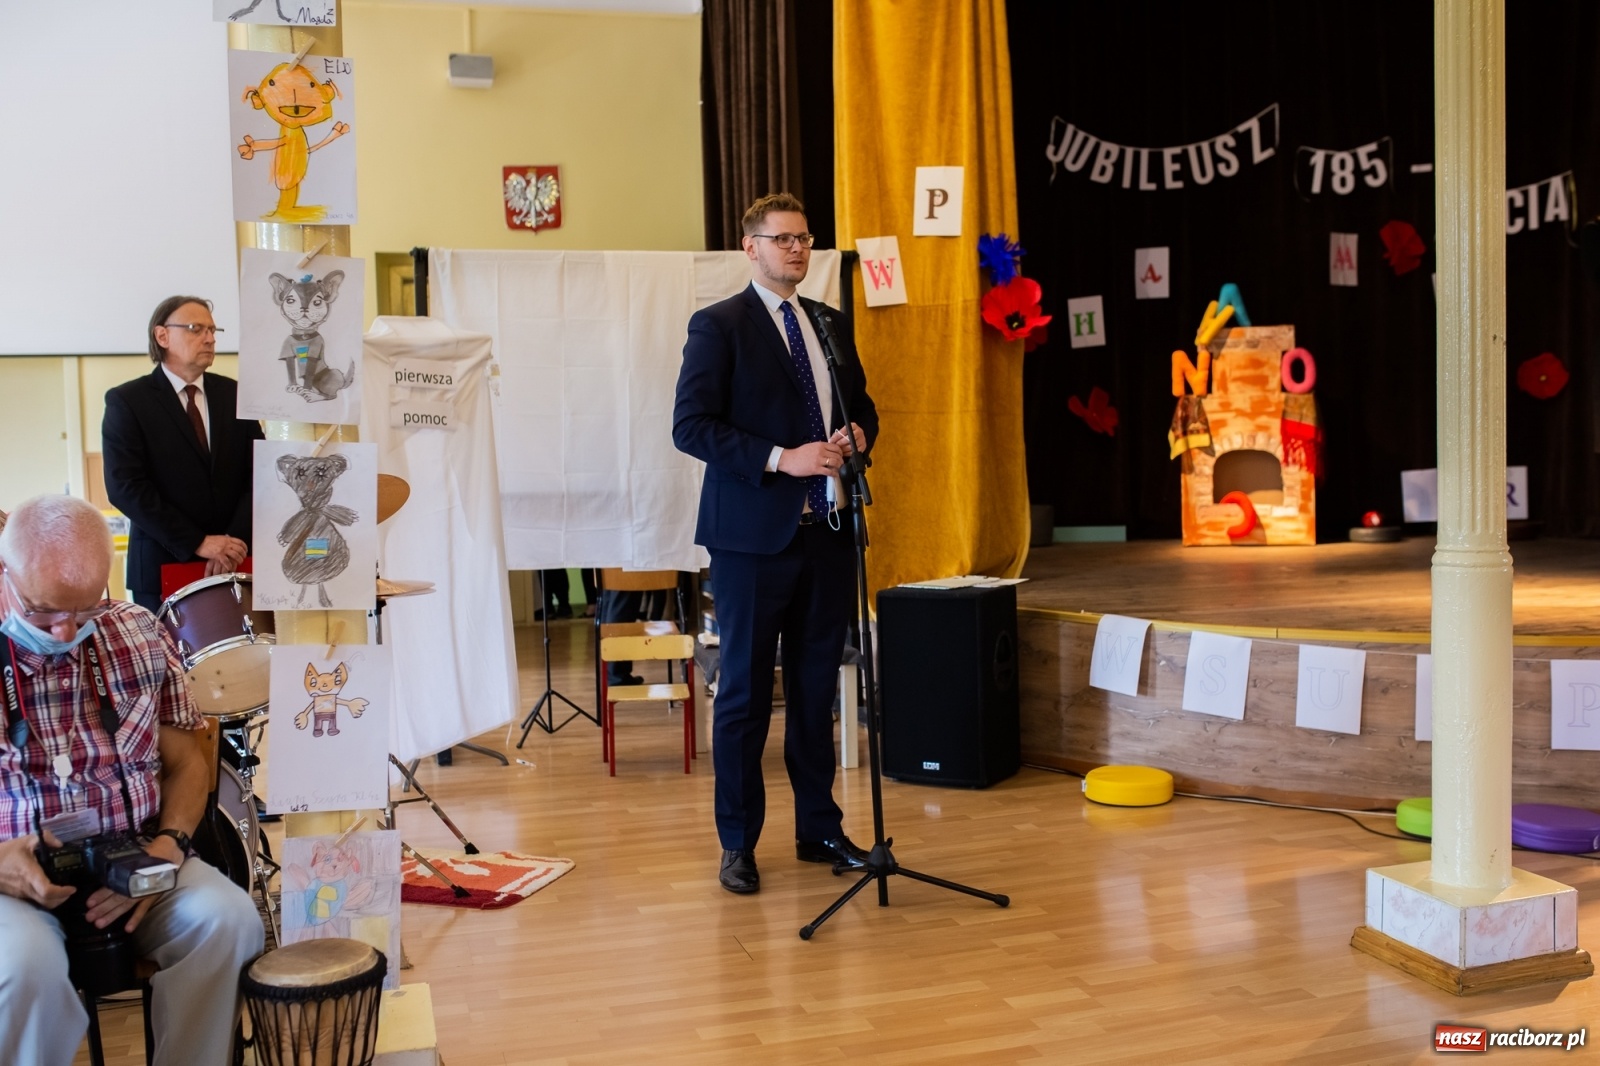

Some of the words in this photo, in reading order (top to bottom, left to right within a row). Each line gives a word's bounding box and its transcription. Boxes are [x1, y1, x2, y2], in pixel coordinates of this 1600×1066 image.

[1046, 117, 1275, 191] JUBILEUSZ
[1309, 142, 1388, 195] 185
[924, 188, 949, 220] P
[863, 258, 896, 291] W
[1140, 263, 1163, 284] A
[1073, 311, 1097, 337] H
[395, 368, 453, 385] pierwsza
[1172, 350, 1211, 397] N
[403, 412, 448, 426] pomoc
[88, 647, 98, 663] 6D
[1098, 631, 1138, 674] W
[1200, 654, 1226, 696] S
[1306, 667, 1349, 711] U
[4, 665, 18, 711] Canon
[92, 666, 107, 696] EOS
